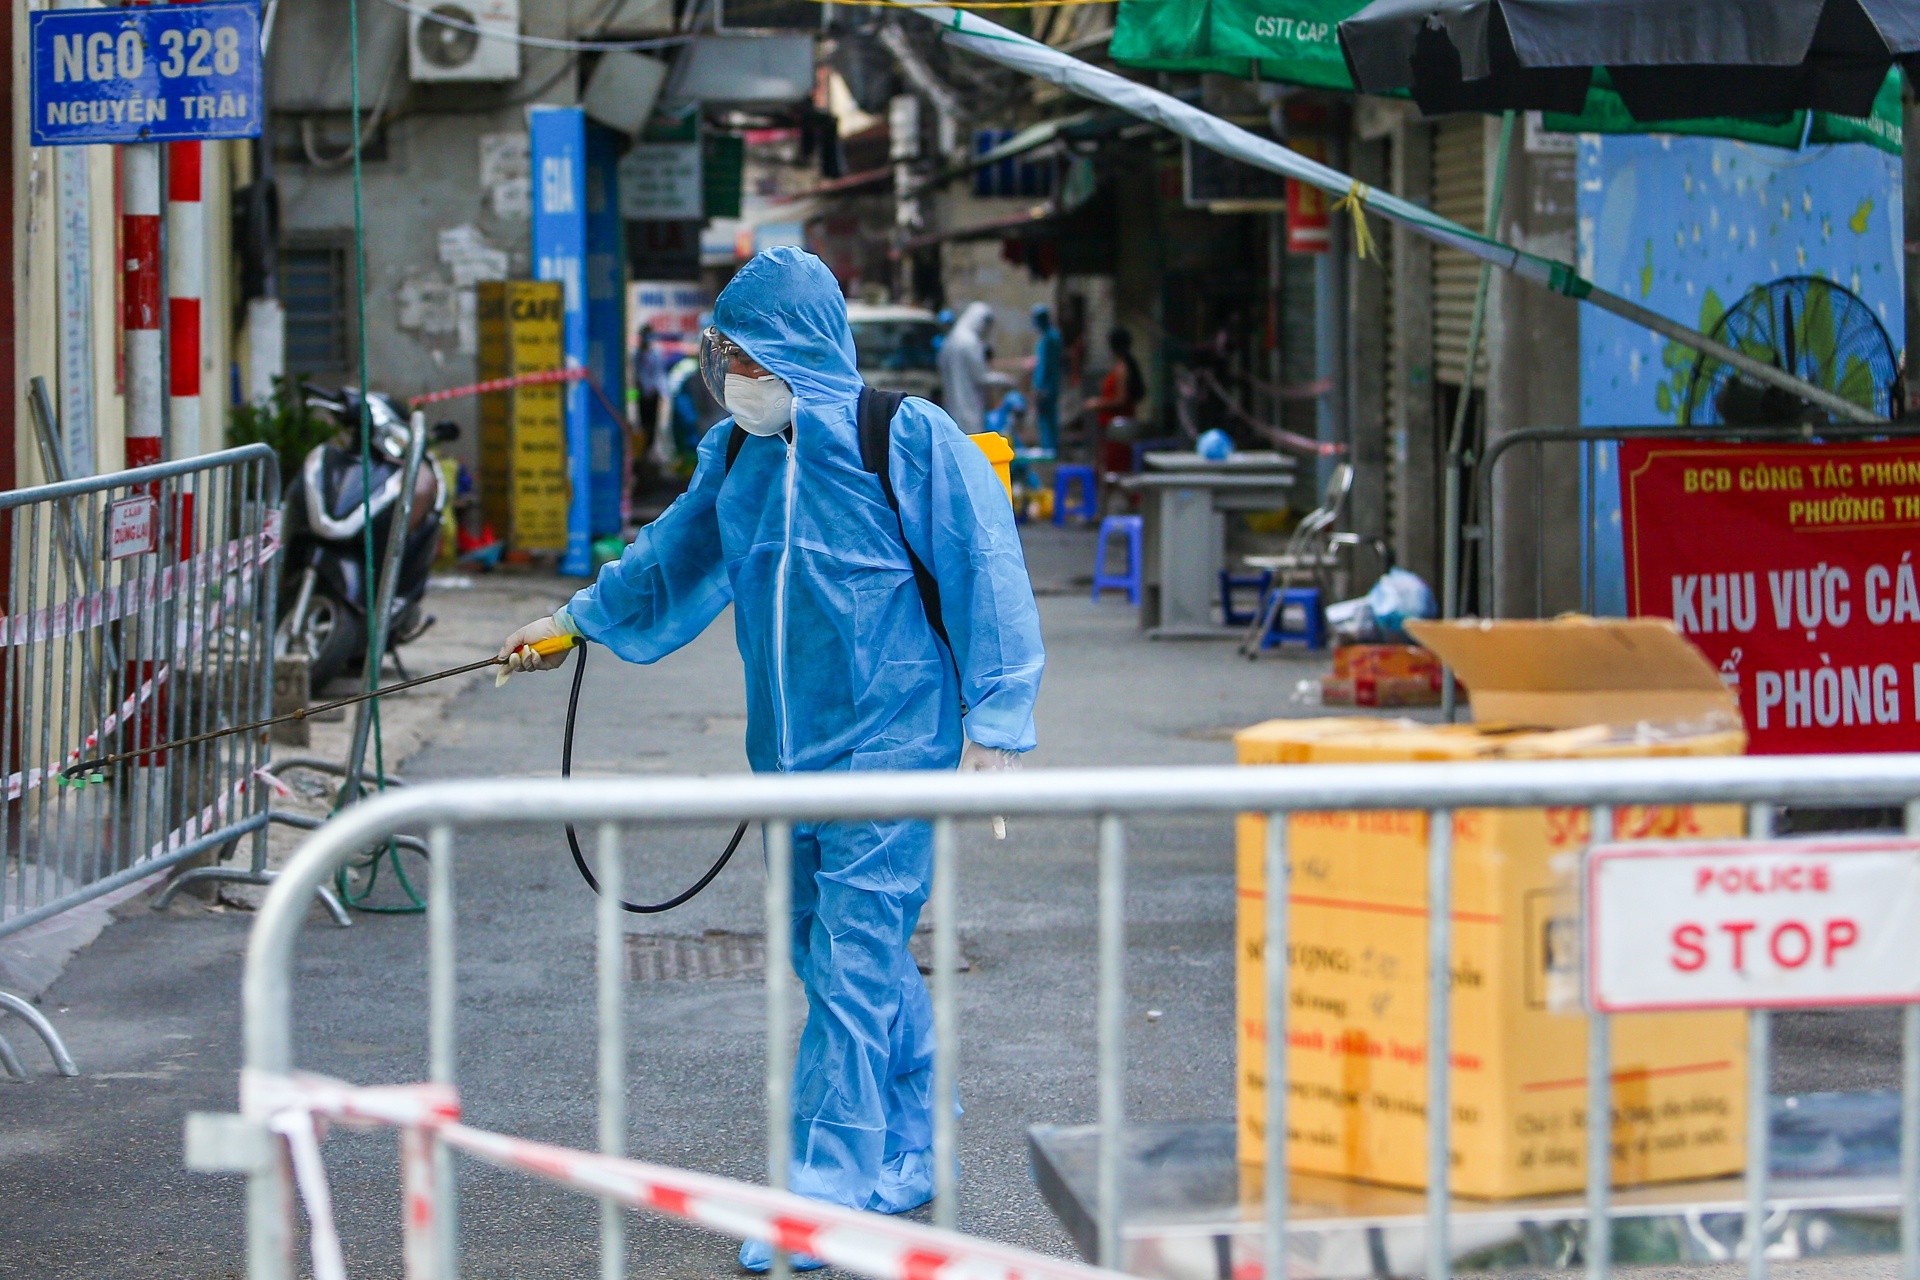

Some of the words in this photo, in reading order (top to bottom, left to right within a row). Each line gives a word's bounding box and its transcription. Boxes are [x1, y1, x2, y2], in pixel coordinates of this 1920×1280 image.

[1255, 15, 1294, 38] CSTT
[159, 26, 240, 78] 328
[47, 91, 167, 125] NGUYỄN
[180, 90, 247, 119] TRÃI
[1739, 462, 1803, 491] CÔNG
[1810, 461, 1854, 488] TÁC
[1789, 493, 1885, 525] PHƯỜNG
[1671, 571, 1757, 634] KHU
[1767, 561, 1850, 643] VỰC
[1755, 653, 1900, 730] PHÒNG
[1695, 865, 1830, 894] POLICE
[1670, 919, 1859, 974] STOP
